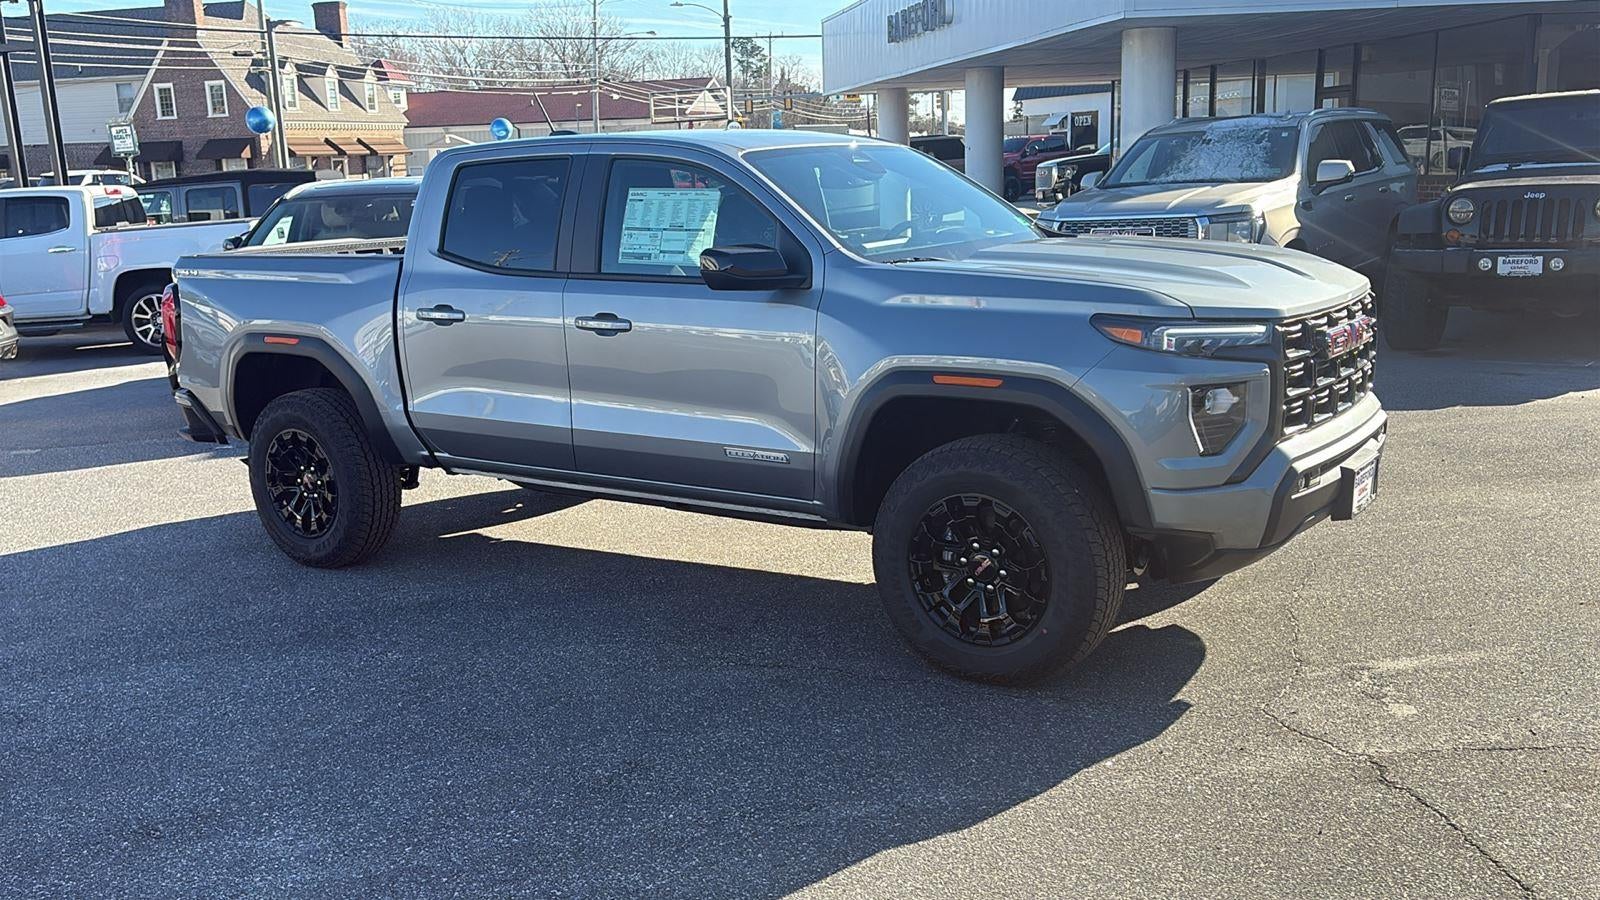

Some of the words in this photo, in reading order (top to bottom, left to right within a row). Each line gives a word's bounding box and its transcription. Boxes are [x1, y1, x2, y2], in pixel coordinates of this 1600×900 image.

[887, 0, 954, 44] BAREFORD
[1074, 115, 1092, 126] OPEN
[1523, 191, 1546, 199] Jeep
[1325, 315, 1376, 357] GMC
[727, 450, 786, 462] ELEVATION
